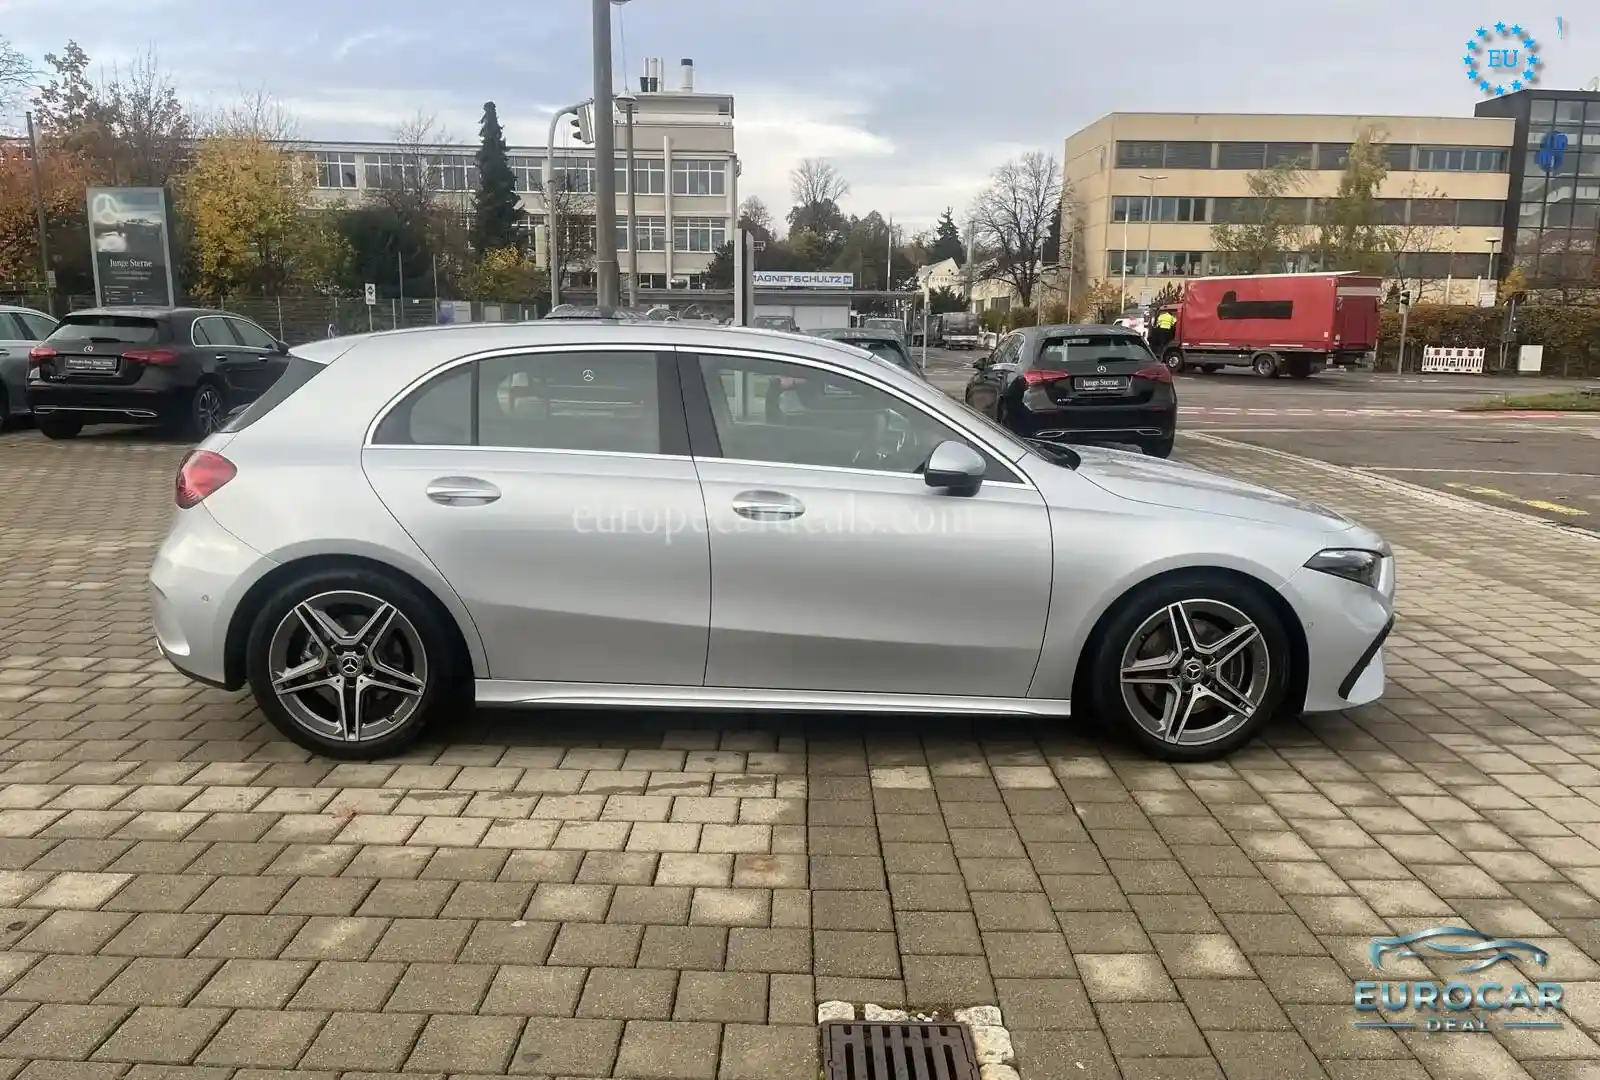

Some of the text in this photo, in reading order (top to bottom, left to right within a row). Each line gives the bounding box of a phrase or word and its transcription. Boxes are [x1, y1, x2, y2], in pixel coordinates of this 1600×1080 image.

[110, 258, 153, 268] Junge Sterne
[1083, 379, 1099, 387] Junge
